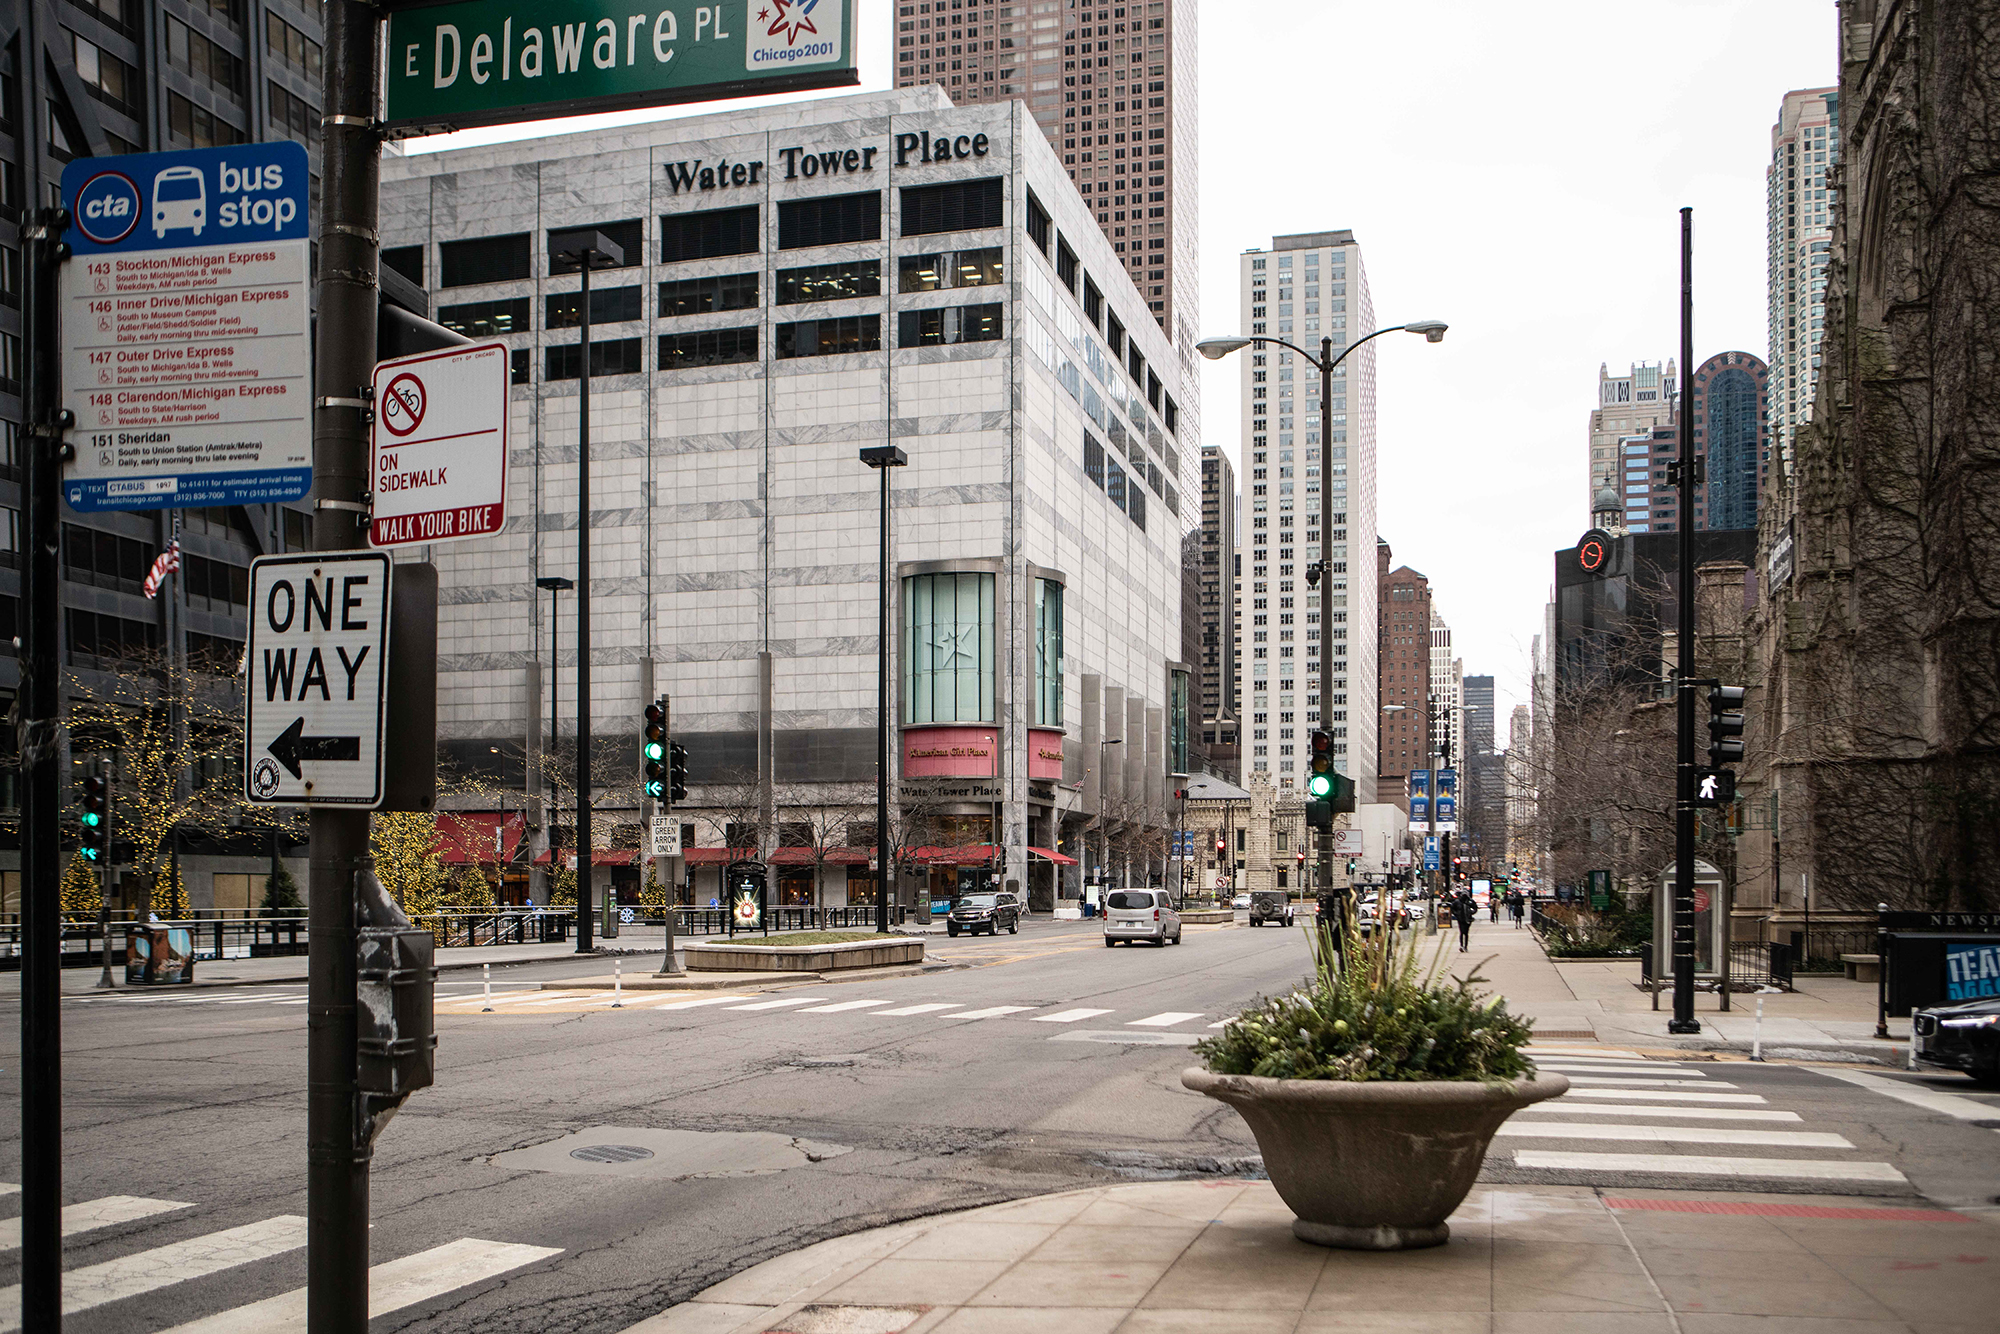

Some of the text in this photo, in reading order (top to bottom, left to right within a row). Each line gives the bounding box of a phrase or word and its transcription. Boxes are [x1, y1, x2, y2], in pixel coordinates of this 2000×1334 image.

[406, 6, 729, 90] E Delaware PL
[753, 42, 834, 64] Chicago2001
[664, 130, 990, 193] Water Tower Place
[219, 161, 283, 193] bus
[86, 194, 130, 219] cta
[219, 195, 296, 232] stop
[88, 252, 276, 276] 143 Stockton/Michigan Express
[116, 273, 138, 282] South
[150, 270, 198, 280] Michigan/Ida
[211, 267, 232, 275] Wells
[116, 282, 157, 291] Weekdays,
[193, 277, 217, 287] period
[88, 290, 289, 313] 146 Inner Drive/Michigan Express
[117, 313, 139, 322] South
[185, 309, 216, 318] Campus
[219, 316, 241, 326] Field)
[117, 326, 258, 342] Daily, early morning thru mid-evening
[89, 346, 234, 364] 147 Outer Drive Express
[117, 366, 139, 374] South
[151, 362, 200, 372] Michigan/Ida
[117, 376, 138, 385] Daily,
[140, 375, 158, 383] early
[161, 373, 192, 381] morning
[212, 369, 258, 377] mid-evening
[89, 385, 287, 406] 148 Clarendon/Michigan Express
[118, 407, 140, 415] South
[152, 403, 207, 412] State/Harrison
[118, 416, 158, 425] Weekdays,
[195, 412, 219, 422] period
[92, 432, 170, 447] 151 Sheridan
[118, 447, 140, 456] South
[176, 444, 203, 452] Station
[205, 441, 262, 452] (Amtrak/Metra)
[118, 458, 139, 467] Daily,
[141, 457, 160, 466] early
[162, 455, 193, 464] morning
[212, 453, 227, 461] late
[229, 452, 259, 461] evening
[380, 453, 398, 472] ON
[109, 482, 145, 492] CTABUS
[223, 477, 257, 485] estimated
[379, 467, 447, 493] SIDEWALK
[97, 496, 163, 505] transitchicago.com
[174, 493, 191, 502] (312)
[193, 492, 225, 500] 836-7000
[249, 490, 267, 498] (312)
[380, 507, 492, 542] WALK YOUR BIKE
[268, 576, 369, 633] ONE
[264, 646, 371, 702] WAY
[914, 748, 988, 757] American Girl Place
[652, 818, 668, 826] LEFT
[1426, 838, 1437, 851] H
[1946, 948, 2000, 982] TEA
